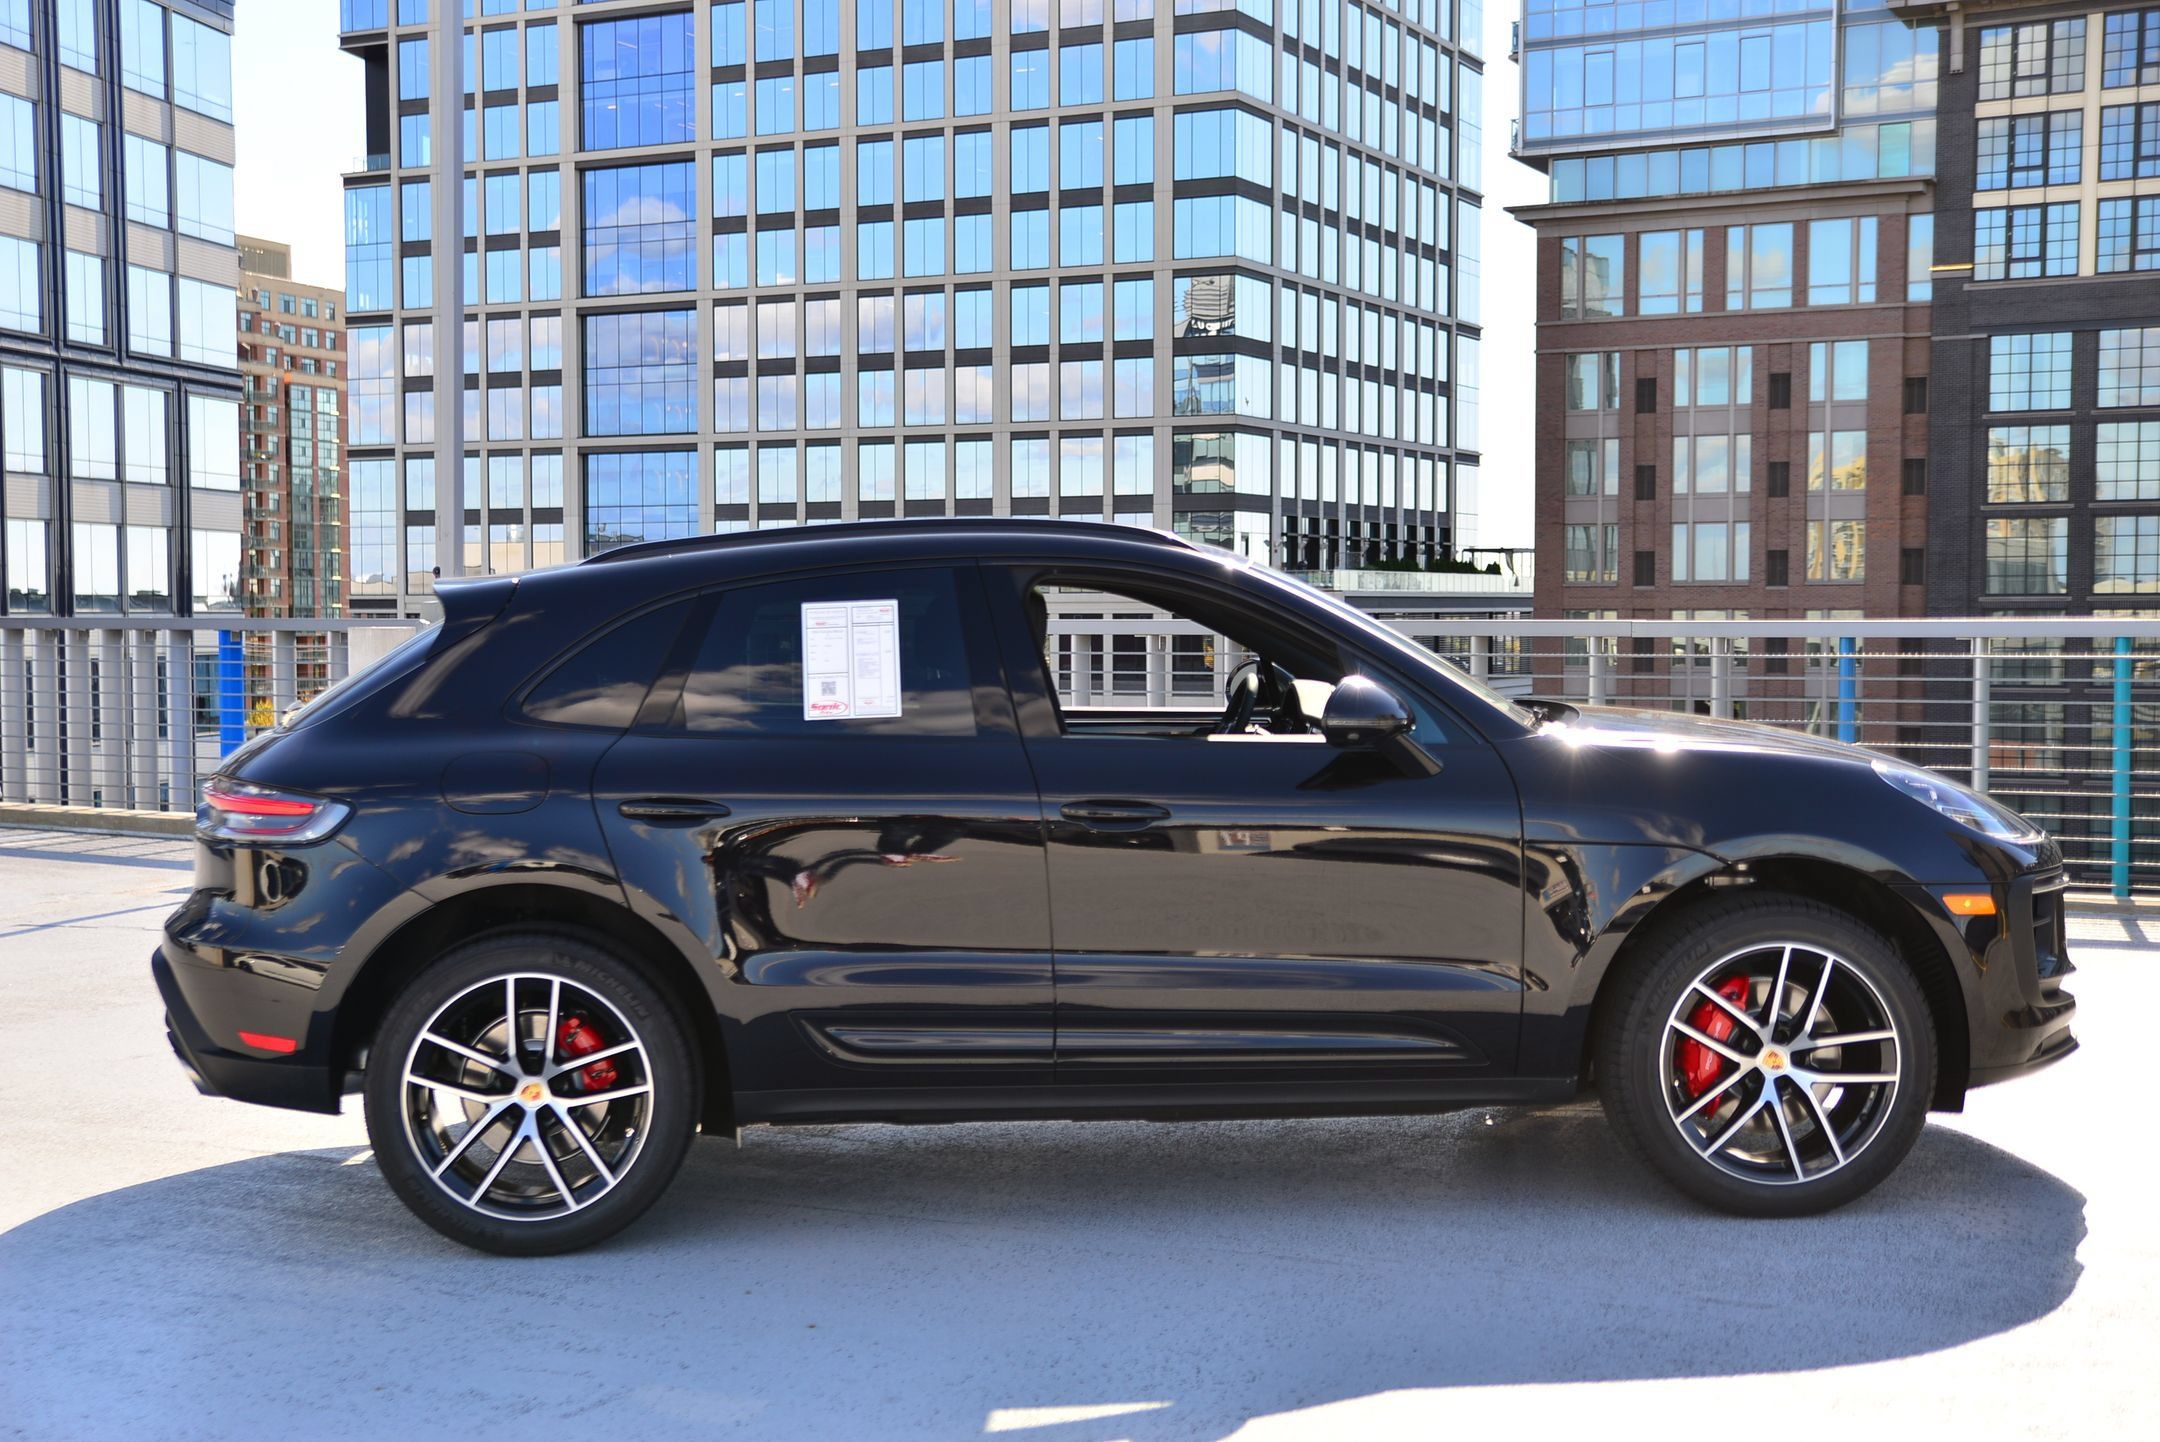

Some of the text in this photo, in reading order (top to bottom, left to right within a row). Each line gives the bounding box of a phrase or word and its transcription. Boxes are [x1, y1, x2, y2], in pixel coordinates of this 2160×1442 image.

[811, 703, 842, 711] Sonic
[574, 959, 651, 1020] MICHELIN
[1649, 941, 1710, 1010] MICHELIN
